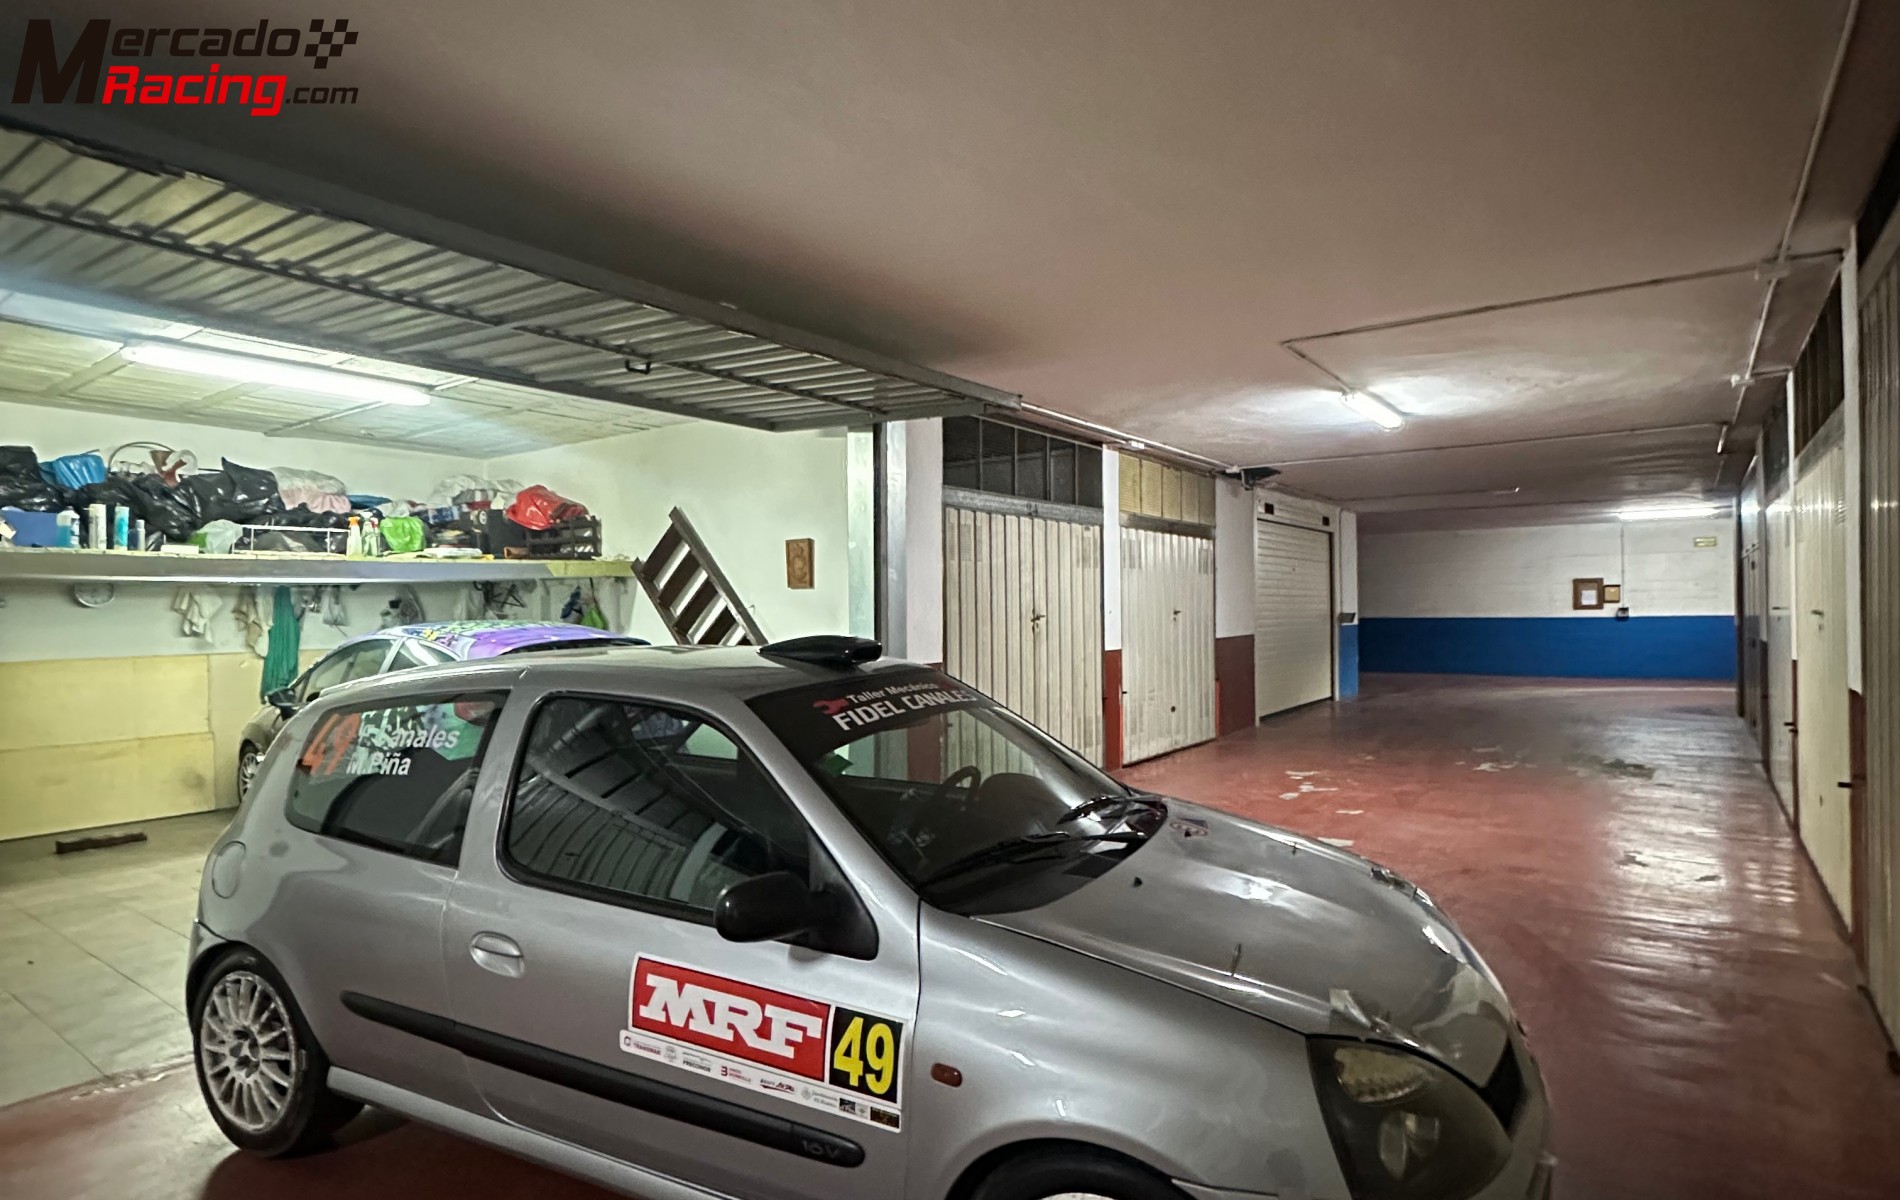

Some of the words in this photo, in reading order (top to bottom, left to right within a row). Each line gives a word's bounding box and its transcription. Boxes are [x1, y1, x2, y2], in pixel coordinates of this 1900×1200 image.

[832, 700, 907, 731] FIDEL
[901, 688, 977, 710] CANALES
[847, 689, 887, 704] Taller
[639, 973, 823, 1058] MRF
[833, 1016, 895, 1095] 49
